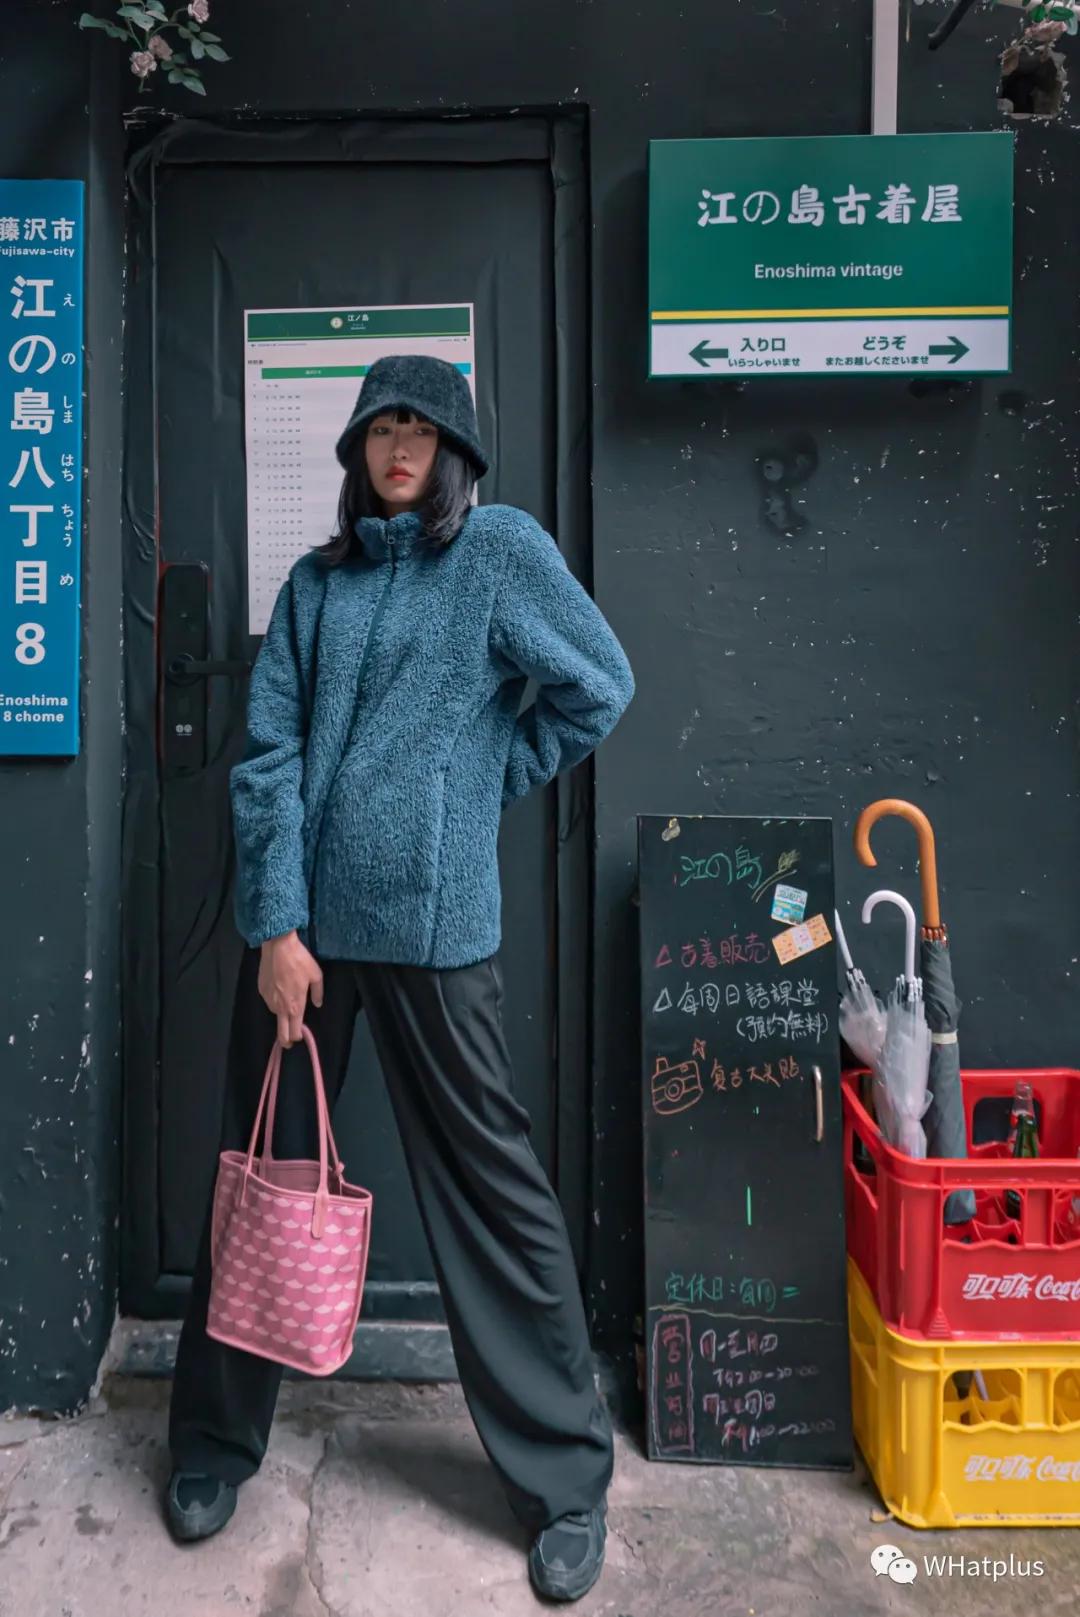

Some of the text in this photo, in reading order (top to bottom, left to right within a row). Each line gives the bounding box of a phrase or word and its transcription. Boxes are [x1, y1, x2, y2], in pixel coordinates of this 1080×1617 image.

[698, 184, 963, 227] 江の島古着屋
[0, 216, 76, 241] 藤沢市
[0, 246, 75, 258] ujisawa-city
[754, 262, 904, 281] Enoshima vintage
[740, 337, 786, 352] 入り口
[862, 335, 907, 351] どうぞ
[728, 357, 801, 367] いらっしゃいませ
[825, 355, 929, 366] またお越しくださいませ
[3, 710, 64, 722] 8 chome
[962, 1273, 1037, 1300] 可口可乐
